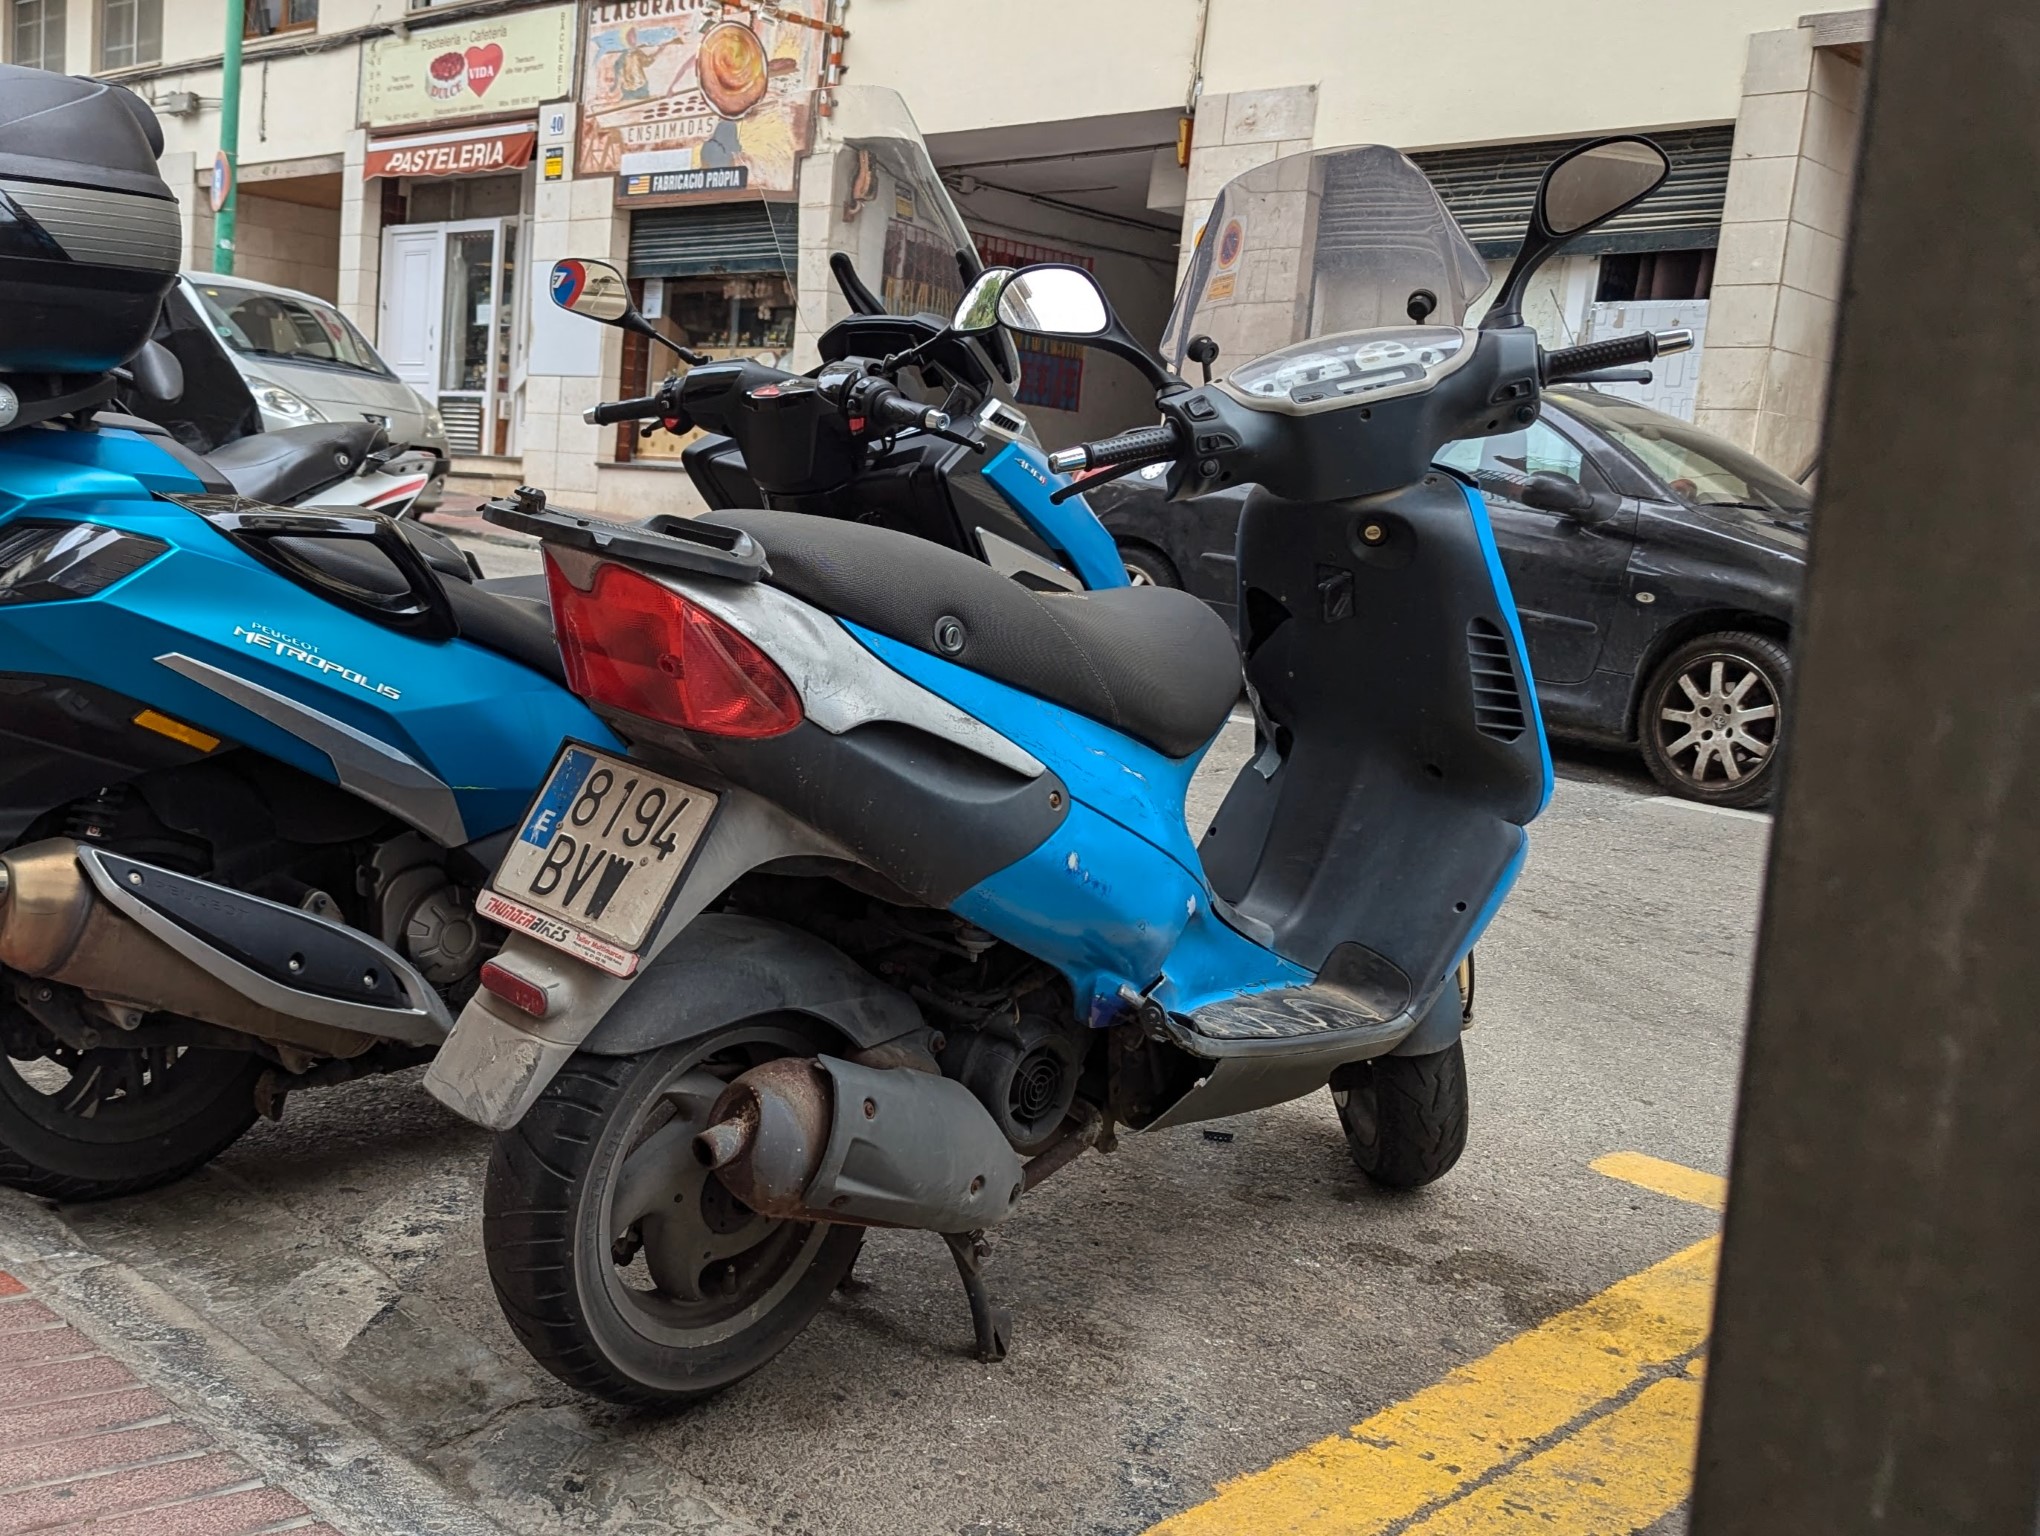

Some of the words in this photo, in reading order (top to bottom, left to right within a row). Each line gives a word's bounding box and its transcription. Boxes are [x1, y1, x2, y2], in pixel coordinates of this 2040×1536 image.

[468, 65, 495, 80] VIDA
[430, 79, 464, 99] DULCE
[550, 115, 563, 132] 40
[627, 117, 714, 143] ENSAIMADAS
[385, 140, 504, 173] PASTELERIA
[652, 171, 704, 192] FABRICACIÓ
[705, 168, 740, 188] PRÒPIA
[251, 621, 320, 654] PEUGEOT
[233, 625, 402, 700] METROPOLIS
[533, 808, 556, 834] E
[571, 768, 690, 861] 8194
[484, 897, 570, 943] THUNDERBIKES
